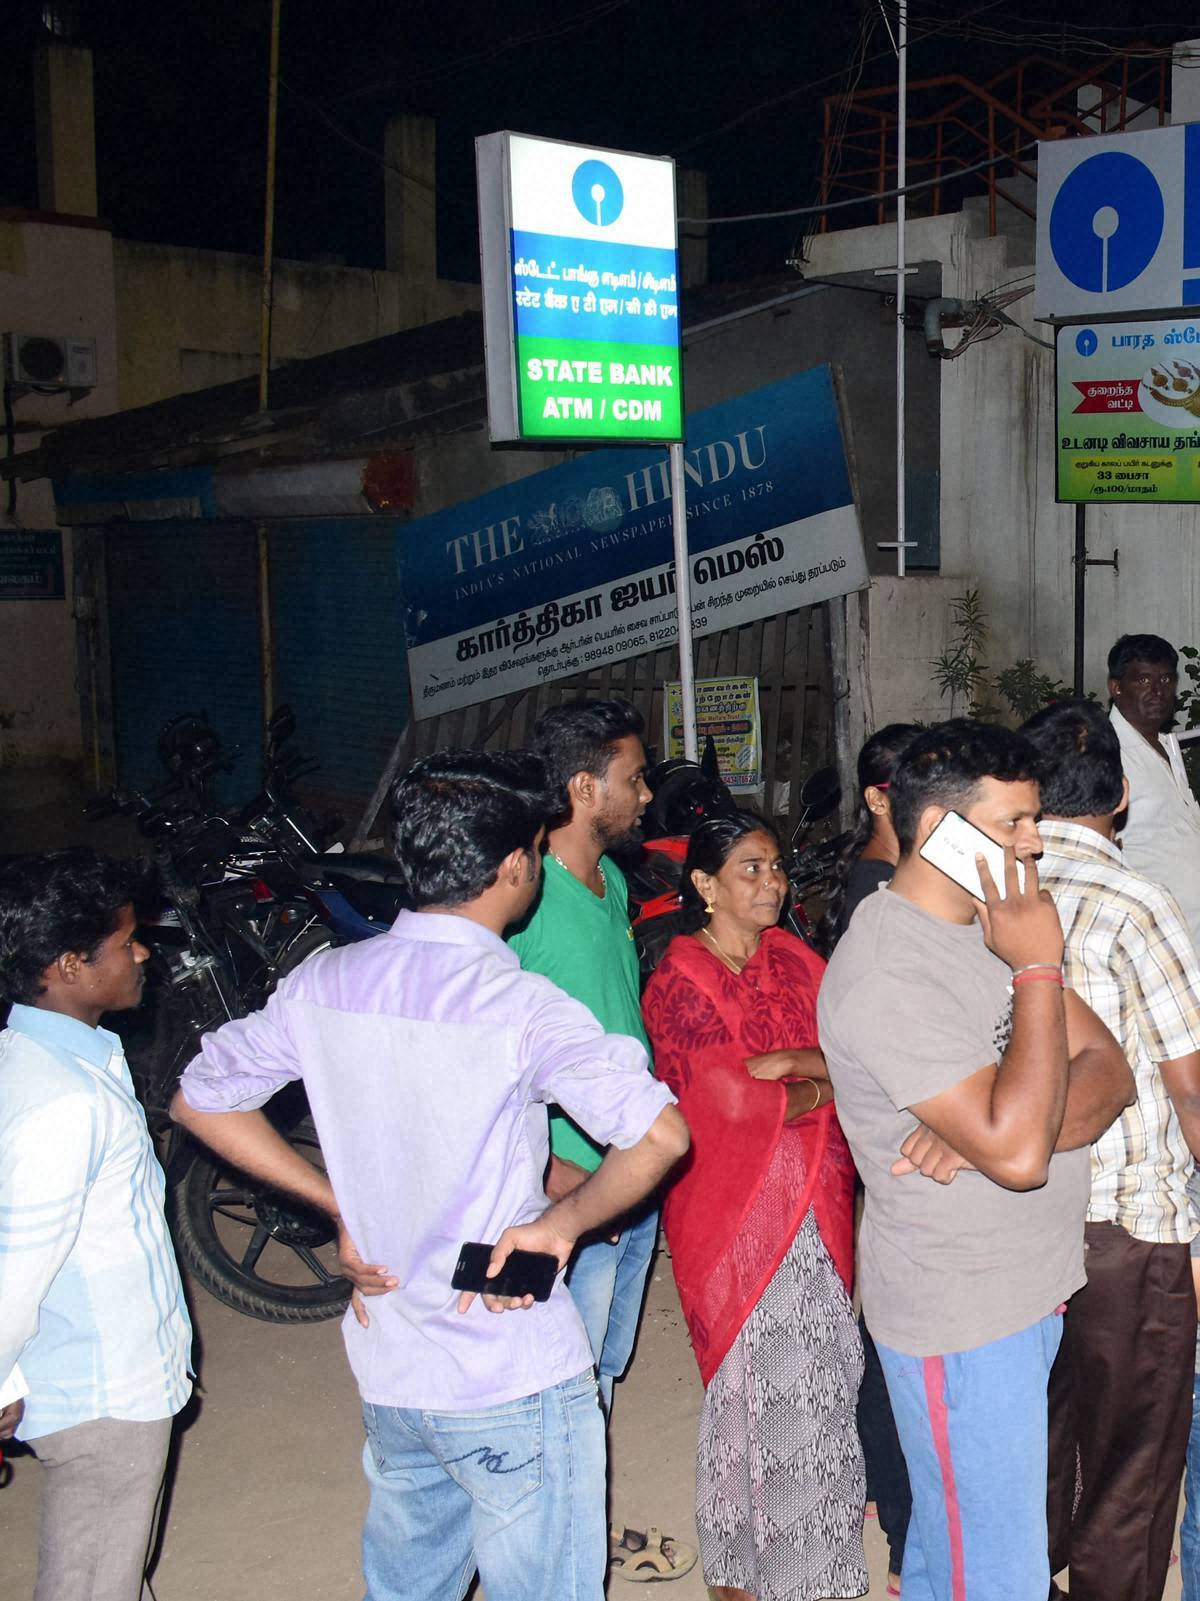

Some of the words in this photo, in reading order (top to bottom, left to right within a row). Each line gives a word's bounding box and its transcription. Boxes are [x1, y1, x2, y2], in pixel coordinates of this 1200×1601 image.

[1111, 334, 1155, 351] பாரத
[527, 358, 603, 384] STATE
[609, 362, 673, 387] BANK
[1087, 382, 1134, 398] குறைந்த
[542, 397, 593, 421] ATM
[599, 400, 606, 420] /
[612, 399, 662, 422] CDM
[1107, 399, 1134, 410] வட்டி
[1062, 434, 1109, 452] உடனடி
[1111, 433, 1170, 450] விவசாய
[1097, 471, 1112, 481] 33
[445, 514, 526, 576] THE
[623, 425, 767, 513] HINDU
[513, 549, 583, 580] NATIONAL
[590, 515, 676, 555] NEWSPAPE
[687, 496, 733, 521] SINCE
[740, 480, 775, 502] 1878
[456, 592, 604, 663] கார்த்திகா
[692, 532, 785, 586] மெஸ்
[584, 646, 614, 664] 98948
[615, 635, 648, 654] 09065,
